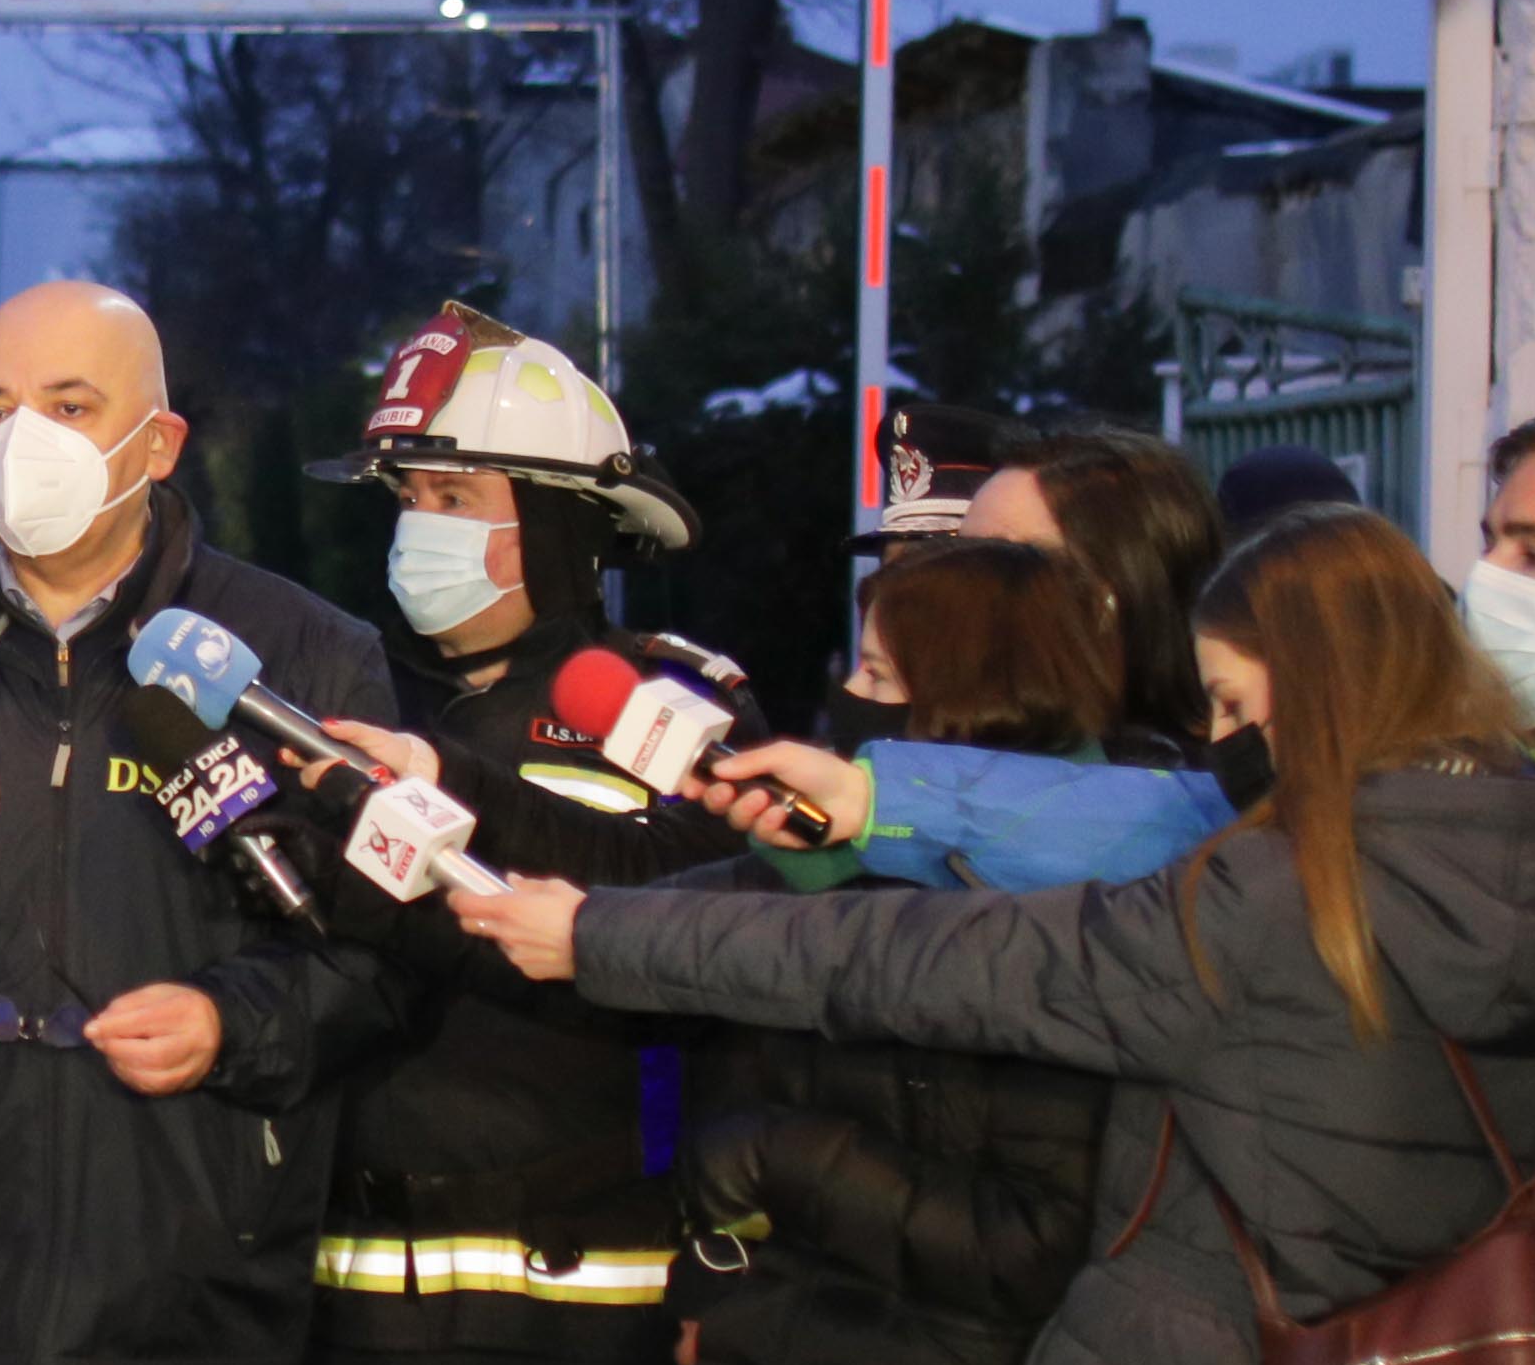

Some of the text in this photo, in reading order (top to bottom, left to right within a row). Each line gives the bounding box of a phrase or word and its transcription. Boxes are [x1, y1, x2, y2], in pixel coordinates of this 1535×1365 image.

[384, 353, 424, 401] 1
[196, 736, 240, 772] DIGI
[208, 753, 267, 803] 24
[156, 767, 195, 806] DIGI
[169, 785, 223, 838] 24
